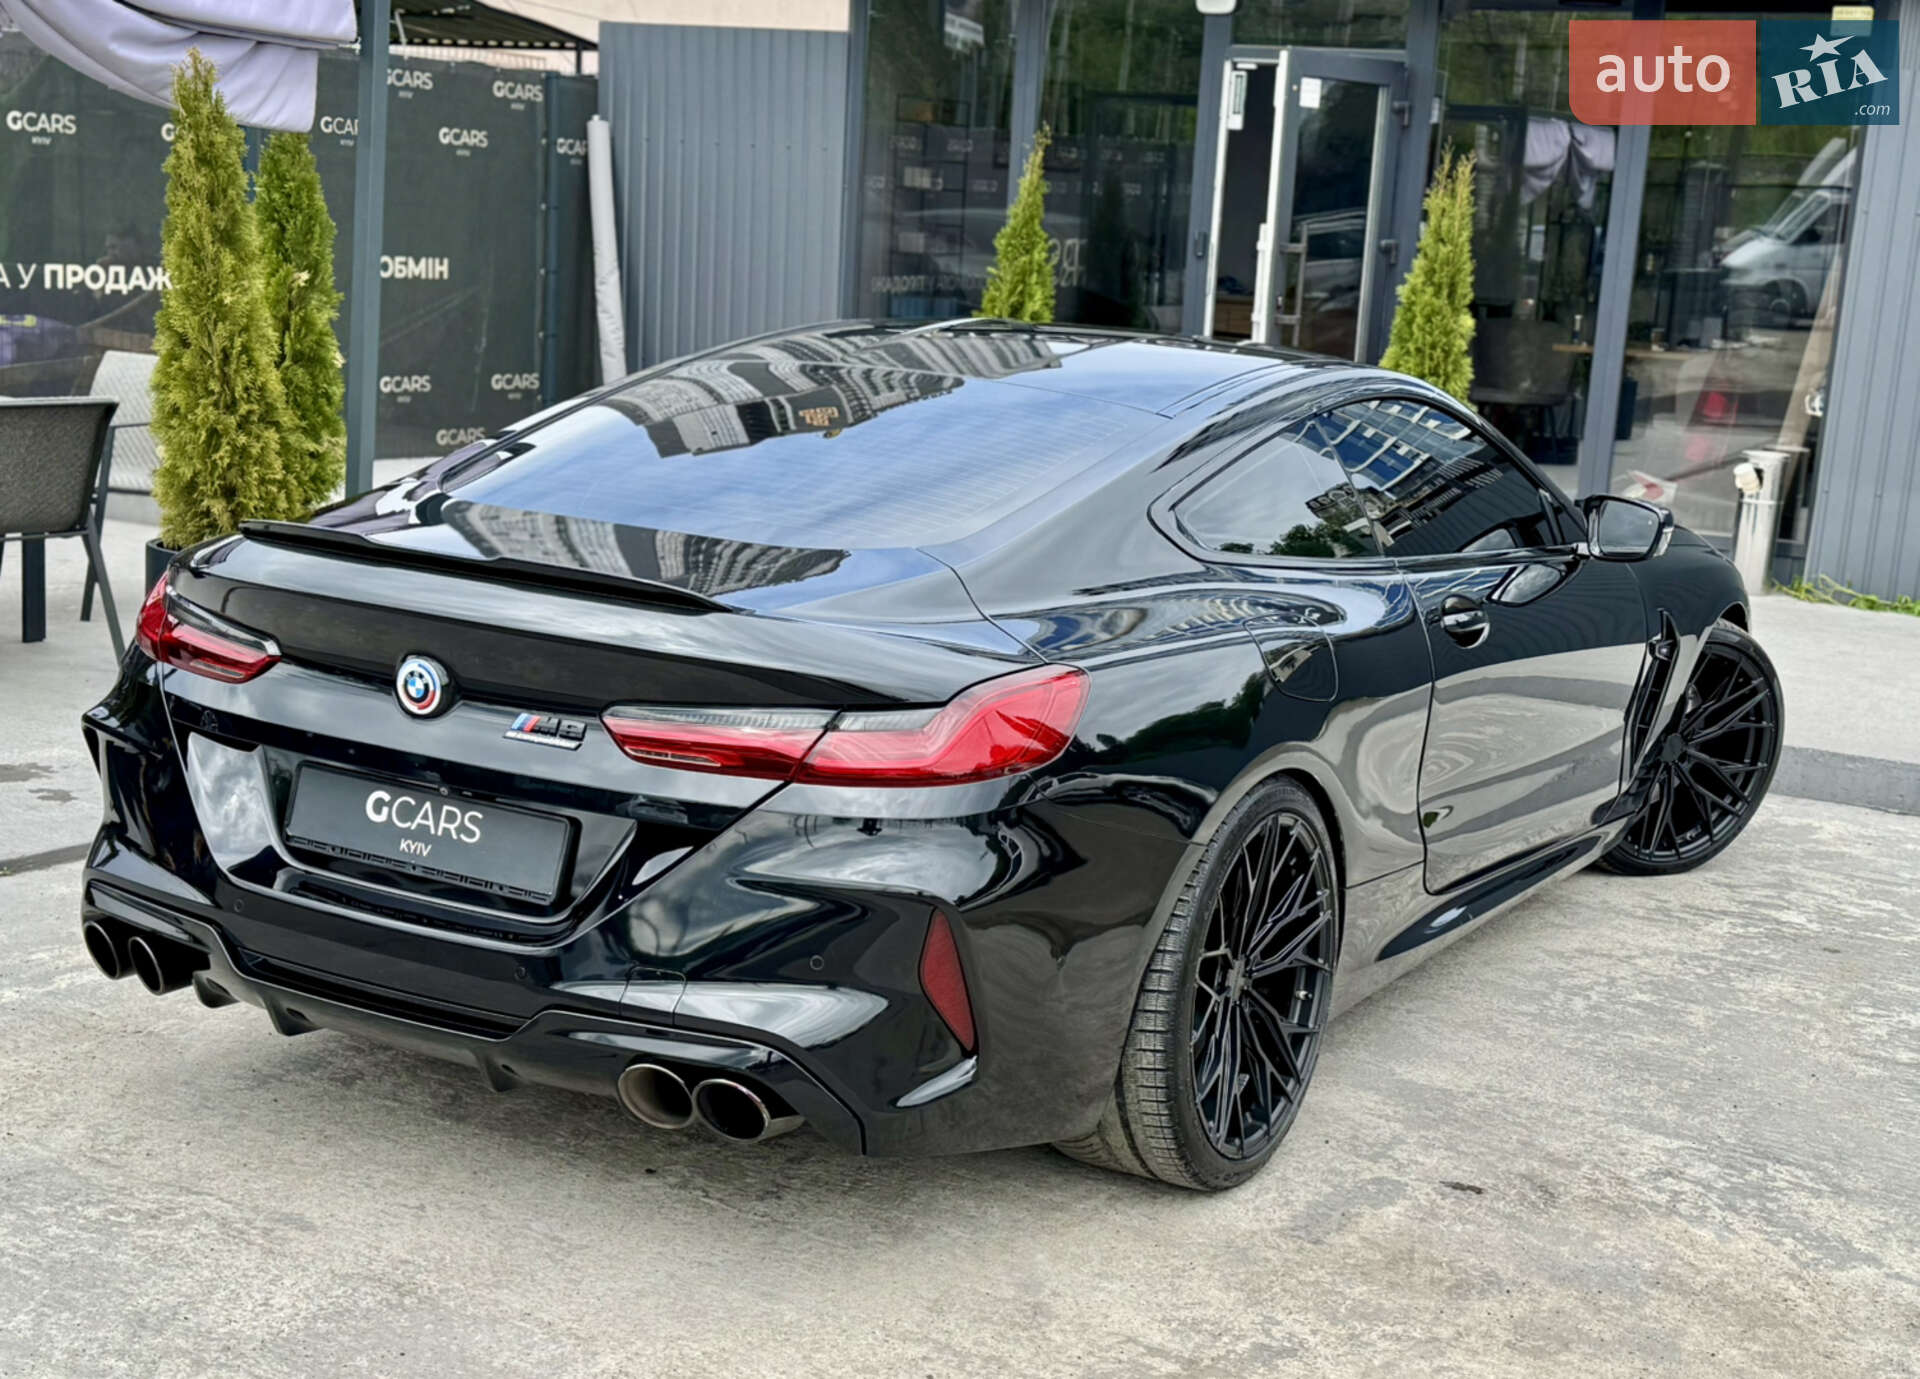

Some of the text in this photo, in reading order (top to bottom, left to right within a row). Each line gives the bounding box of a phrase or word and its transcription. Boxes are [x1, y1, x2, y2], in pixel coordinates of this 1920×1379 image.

[492, 80, 544, 102] GCARS
[6, 110, 77, 135] GCARS
[438, 126, 488, 148] GCARS
[17, 263, 37, 290] У
[380, 255, 449, 280] ОБМІН
[379, 375, 432, 393] GCARS
[491, 373, 540, 390] GCARS
[436, 427, 486, 446] GCARS
[365, 789, 484, 843] GCARS
[400, 838, 432, 857] KYIV
